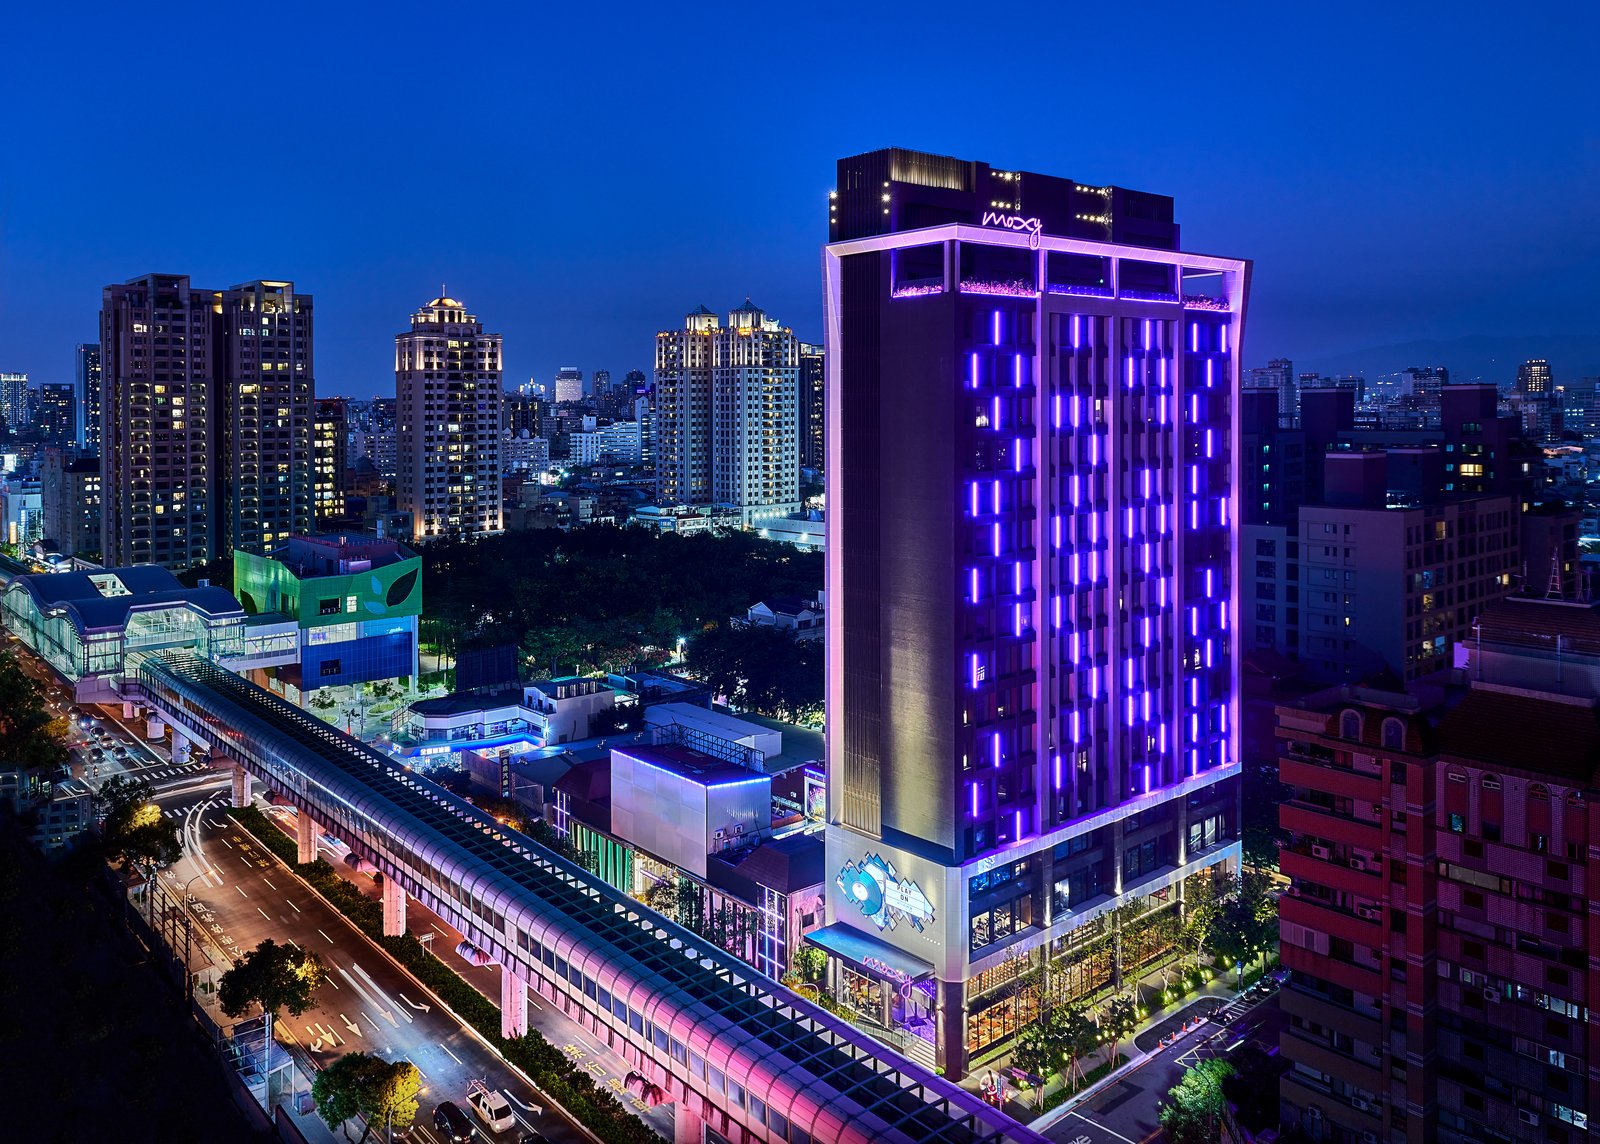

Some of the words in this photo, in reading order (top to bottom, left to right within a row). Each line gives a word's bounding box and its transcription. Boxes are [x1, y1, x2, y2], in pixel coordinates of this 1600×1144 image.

[896, 885, 912, 895] PLAY
[900, 894, 909, 902] ON
[563, 1044, 652, 1113] 禁行機車
